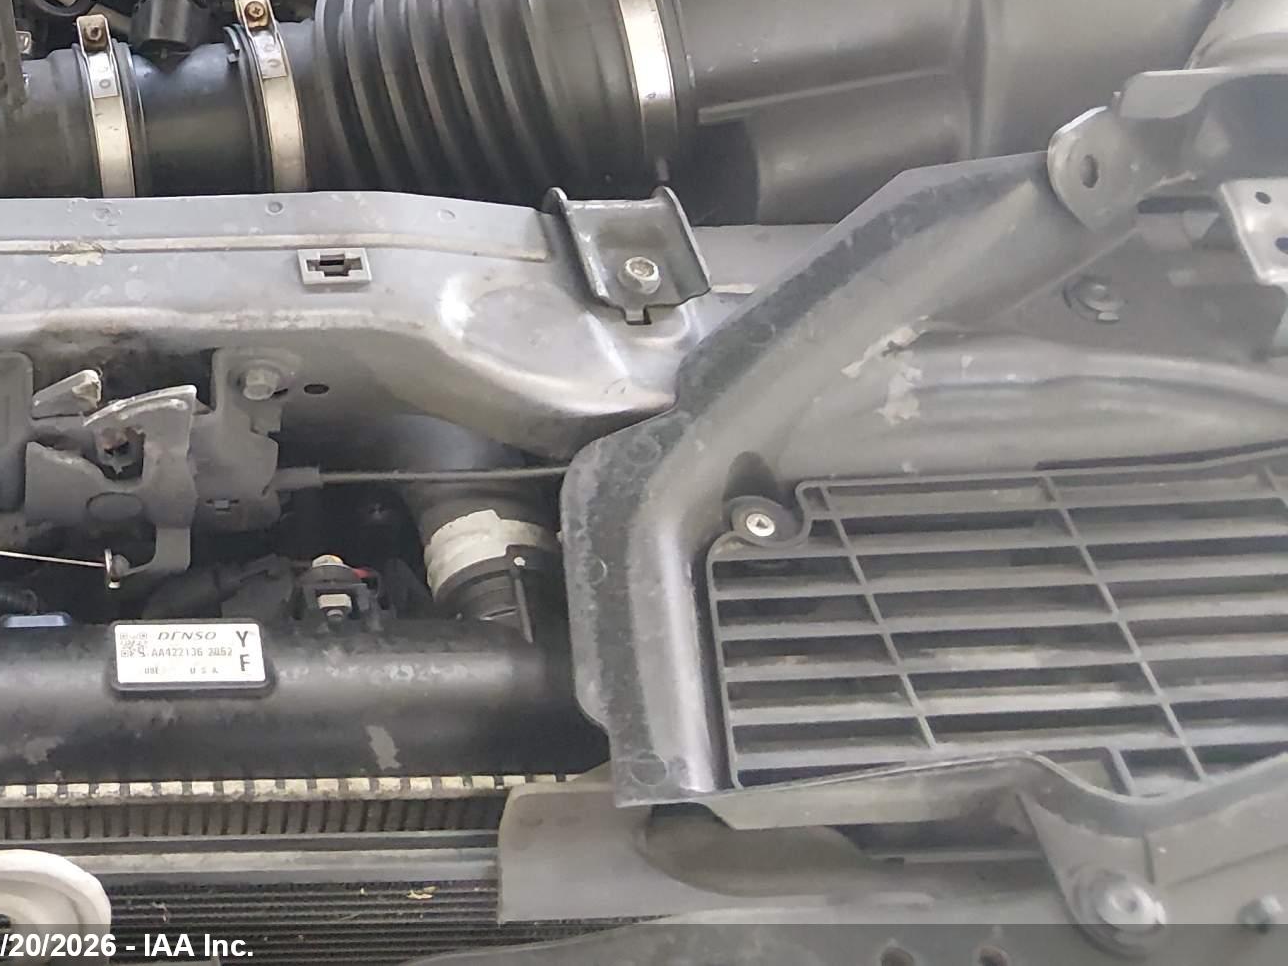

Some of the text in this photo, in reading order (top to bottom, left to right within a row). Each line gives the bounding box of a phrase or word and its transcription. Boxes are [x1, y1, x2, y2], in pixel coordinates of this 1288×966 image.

[157, 631, 217, 641] DENSO
[236, 630, 249, 648] Y
[239, 654, 251, 672] F
